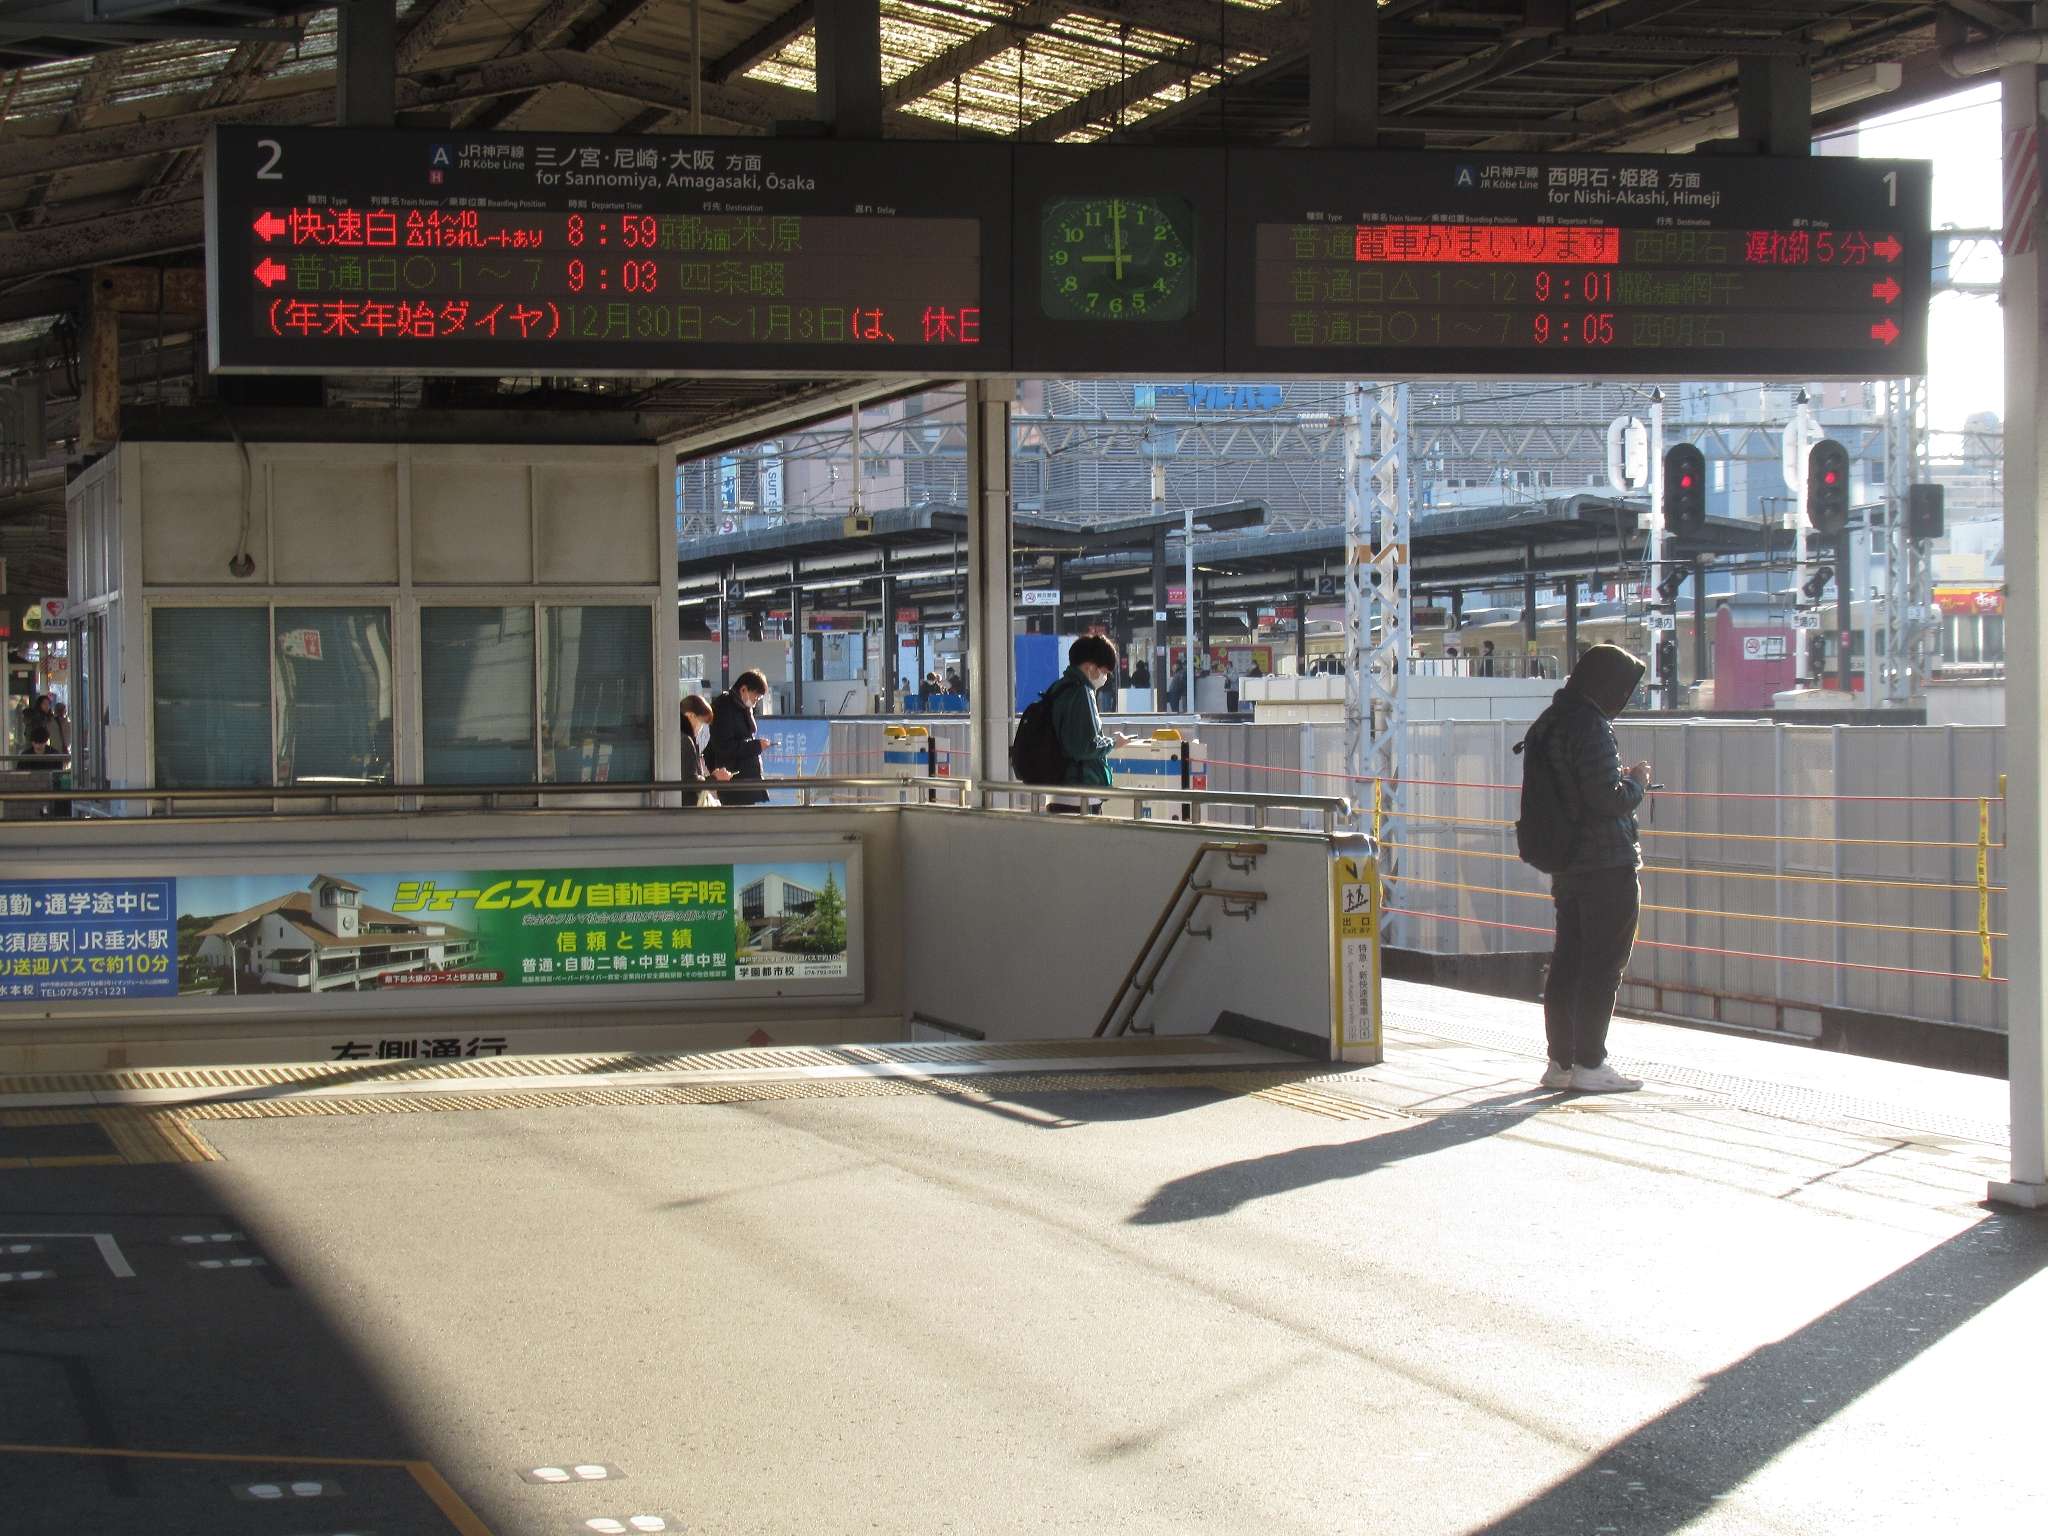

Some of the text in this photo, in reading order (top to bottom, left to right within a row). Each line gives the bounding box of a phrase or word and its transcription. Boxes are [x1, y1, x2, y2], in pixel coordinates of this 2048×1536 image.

[256, 140, 283, 180] 2
[432, 147, 450, 165] A
[458, 145, 525, 159] JR神戸線
[535, 147, 762, 172] 三ノ宮・尼崎・大阪 方面
[458, 160, 471, 169] JR
[503, 160, 525, 170] Line
[1480, 166, 1539, 179] JR神戸線
[430, 171, 443, 184] H
[535, 170, 561, 185] for
[565, 171, 661, 190] Sannomiya,
[666, 173, 761, 191] Amagasaki,
[1458, 169, 1472, 185] A
[1480, 180, 1491, 188] JR
[1519, 179, 1539, 190] Line
[1549, 168, 1701, 188] 西明石・姫路 方面
[1549, 189, 1720, 209] for Nishi-Akashi, Himeji
[1882, 172, 1897, 206] 1
[1357, 225, 1613, 262] 電車がまいります
[768, 471, 777, 496] SUIT
[728, 583, 742, 599] 4
[1321, 577, 1332, 594] 2
[80, 929, 168, 950] JR垂水駅
[557, 928, 693, 952] 信頼と実績
[522, 952, 727, 973] 普通・自動二輪・中型・準中型
[331, 1037, 508, 1061] 左側通行
